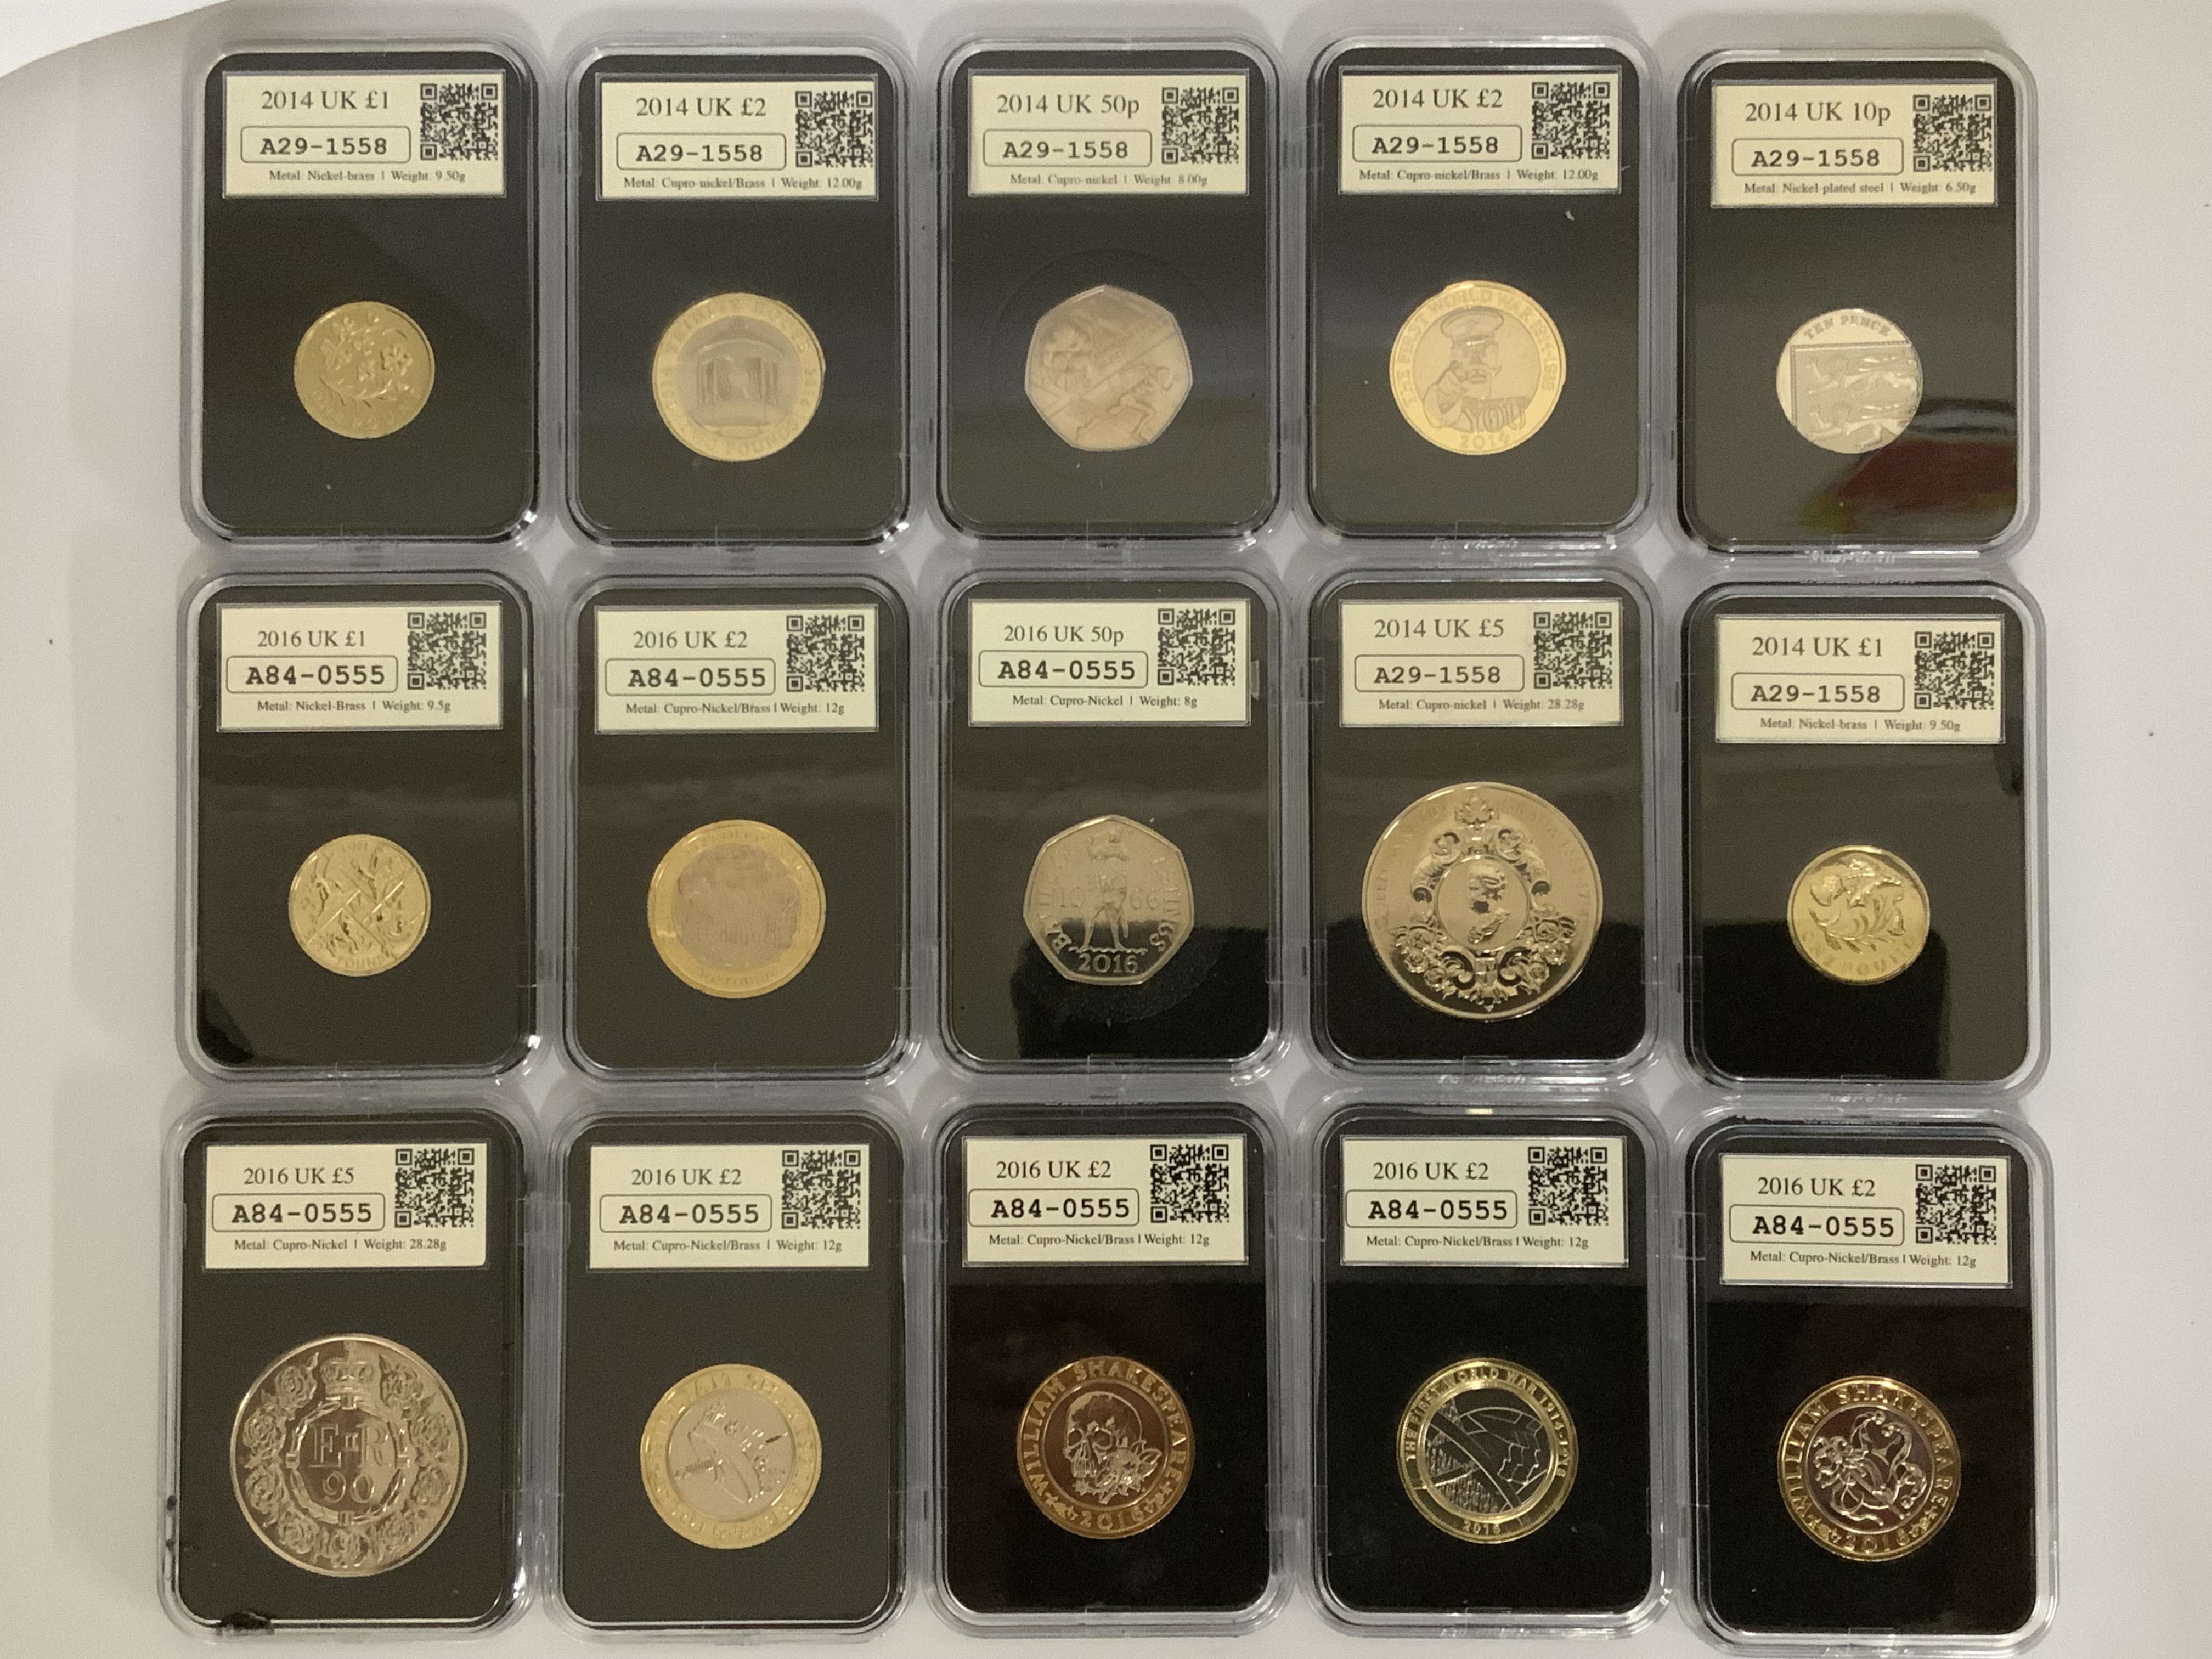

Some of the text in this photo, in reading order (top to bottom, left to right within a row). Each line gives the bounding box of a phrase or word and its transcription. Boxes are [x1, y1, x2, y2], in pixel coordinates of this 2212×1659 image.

[261, 89, 388, 110] 2014 UK £1
[636, 97, 766, 117] 2014 UK £2
[997, 93, 1140, 120] 2014 UK 50p
[1372, 87, 1503, 109] 2014 UK £2
[1745, 101, 1891, 127] 2014 UK 10p
[259, 136, 387, 156] A29-1558
[635, 143, 763, 163] A29-1558
[1002, 140, 1128, 159] A29-1558
[1370, 135, 1499, 155] A29-1558
[1750, 148, 1880, 168] A29-1558
[435, 170, 466, 184] 9.50g
[827, 177, 863, 191] 12.00g
[1178, 173, 1208, 188] 8.00g
[1563, 168, 1599, 182] 12.00g
[1859, 182, 1884, 193] steel
[1945, 181, 1977, 195] 6.50g
[1803, 314, 1892, 340] TEN PENCE
[1462, 402, 1526, 432] YOU
[257, 629, 365, 648] 2016 UK £1
[1003, 624, 1124, 647] 2016 UK 50p
[1374, 618, 1504, 639] 2014 UK £5
[633, 630, 748, 649] 2016 UK £2
[1752, 636, 1882, 657] 2014 UK £1
[244, 663, 385, 686] A84-0555
[627, 667, 766, 689] A84-0555
[997, 659, 1136, 681] A84-0555
[1373, 665, 1501, 684] A29-1558
[1012, 694, 1198, 710] Metal: Cupro-Nickel Weight: 8g
[1750, 684, 1881, 704] A29-1558
[257, 699, 452, 714] Metal: Nickel-Brass Weight: 9.5g
[625, 702, 845, 717] Metal: Cupro-Nickel/Brass Weight: 12g
[1547, 698, 1585, 712] 28.28g
[1929, 719, 1961, 733] 9.50g
[1078, 954, 1139, 974] 2016
[243, 1166, 354, 1186] 2016 UK £5
[631, 1167, 742, 1186] 2016 UK £2
[996, 1160, 1112, 1180] 2016 UK £2
[1373, 1161, 1489, 1181] 2016 UK £2
[1757, 1176, 1876, 1198] 2016 UK £2
[230, 1201, 373, 1224] A84-0555
[618, 1203, 759, 1225] A84-0555
[990, 1197, 1130, 1220] A84-0555
[1367, 1198, 1508, 1221] A84-0555
[1751, 1214, 1895, 1238] A84-0555
[234, 1238, 447, 1253] Metal: Cupro-Nickel Weight: 28.28g
[613, 1239, 843, 1254] Metal: Cupro-Nickel/Brass Weight: 12g
[989, 1233, 1210, 1248] Metal: Cupro-Nickel/Brass Weight: 12g
[1366, 1235, 1589, 1250] Metal: Cupro-Nickel/Brass Weight: 12g
[1750, 1250, 1977, 1269] Metal: Cupro-Nickel/Brass Weight: 12g
[1508, 1372, 1539, 1394] WAR
[1024, 1361, 1187, 1497] WILLIAM SHAKESPEARE
[1785, 1403, 1830, 1517] WILLIAM
[1079, 1509, 1144, 1531] 2016
